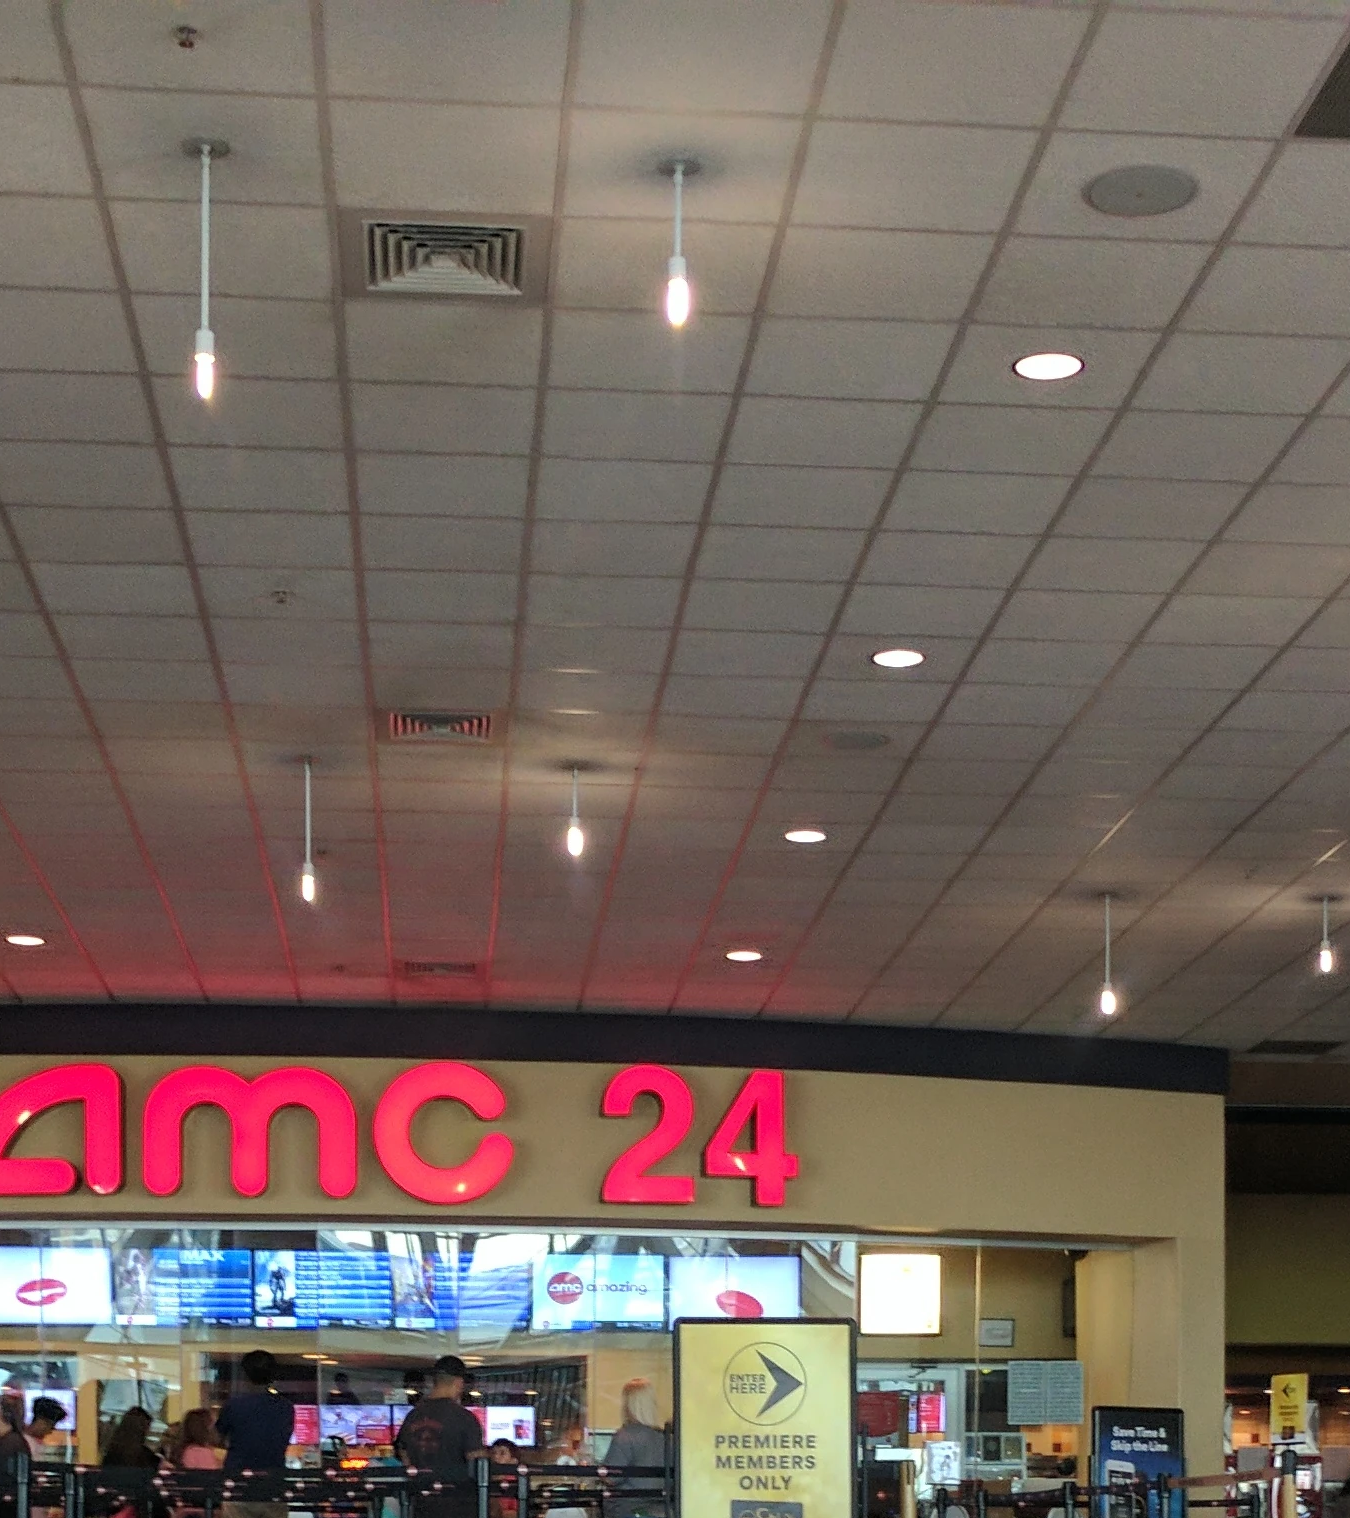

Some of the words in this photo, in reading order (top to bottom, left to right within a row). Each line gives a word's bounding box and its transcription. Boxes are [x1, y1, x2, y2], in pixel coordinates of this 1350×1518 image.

[600, 1063, 801, 1207] 24
[586, 1281, 648, 1296] amazing
[728, 1373, 767, 1383] ENTER
[729, 1383, 767, 1394] HERE
[1111, 1425, 1136, 1438] Save
[1135, 1426, 1159, 1438] Time
[714, 1434, 818, 1450] PREMIERE
[1109, 1438, 1132, 1454] Skip
[1132, 1439, 1149, 1452] the
[1149, 1440, 1169, 1452] Line
[714, 1454, 817, 1470] MEMBERS
[738, 1474, 793, 1491] ONLY
